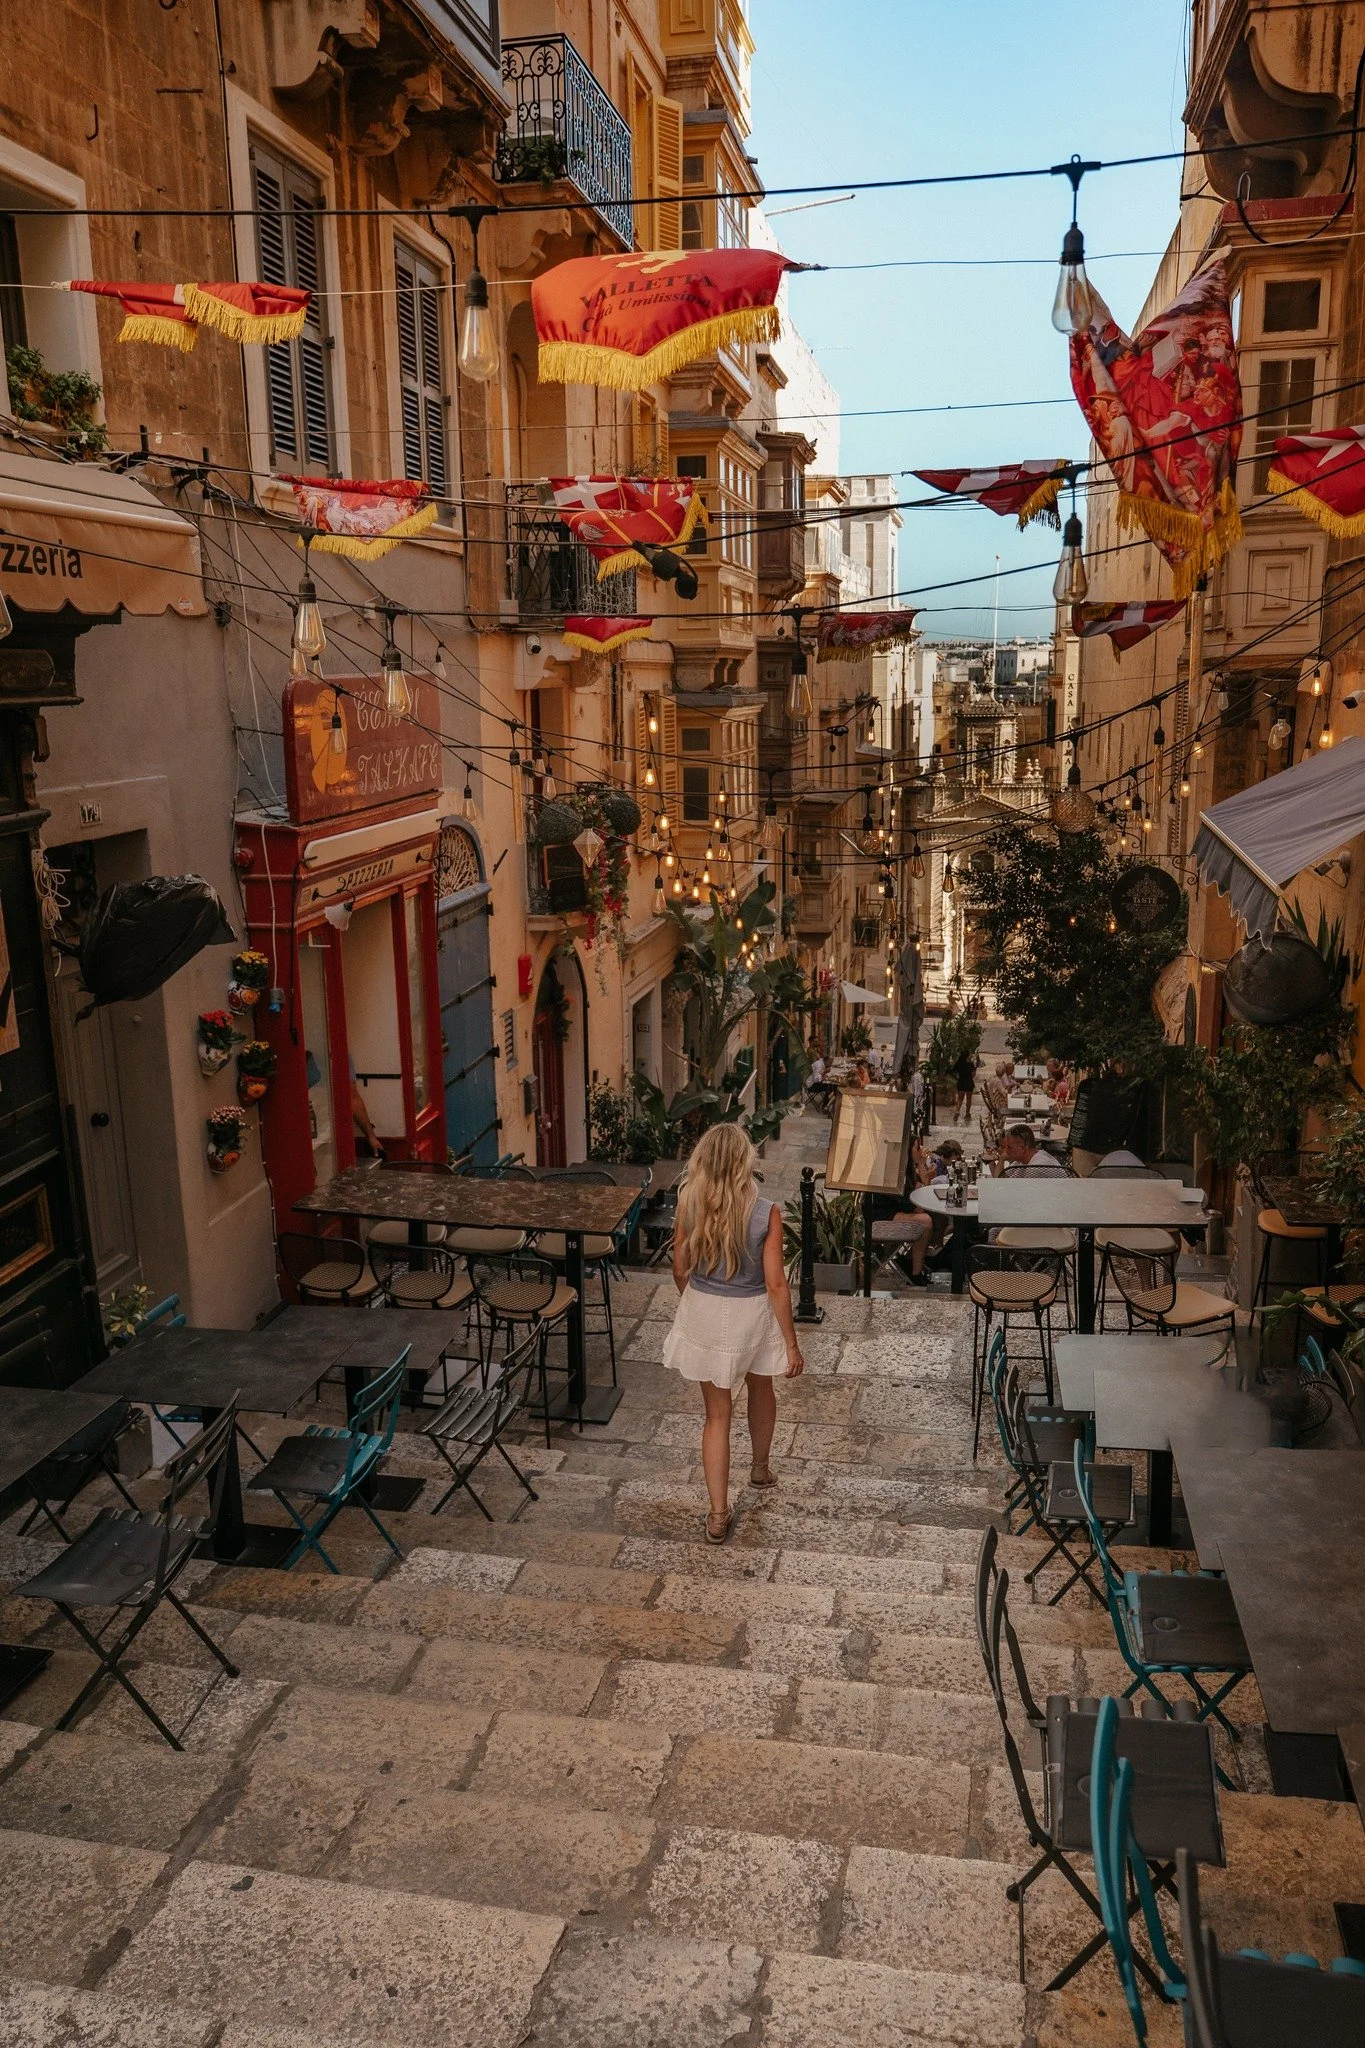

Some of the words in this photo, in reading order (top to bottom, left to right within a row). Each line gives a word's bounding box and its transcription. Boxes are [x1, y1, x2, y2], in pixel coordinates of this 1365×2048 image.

[580, 274, 714, 309] VALLETTA
[1067, 673, 1075, 706] CASA
[347, 859, 394, 888] PIZZERIA
[568, 1241, 577, 1249] 16
